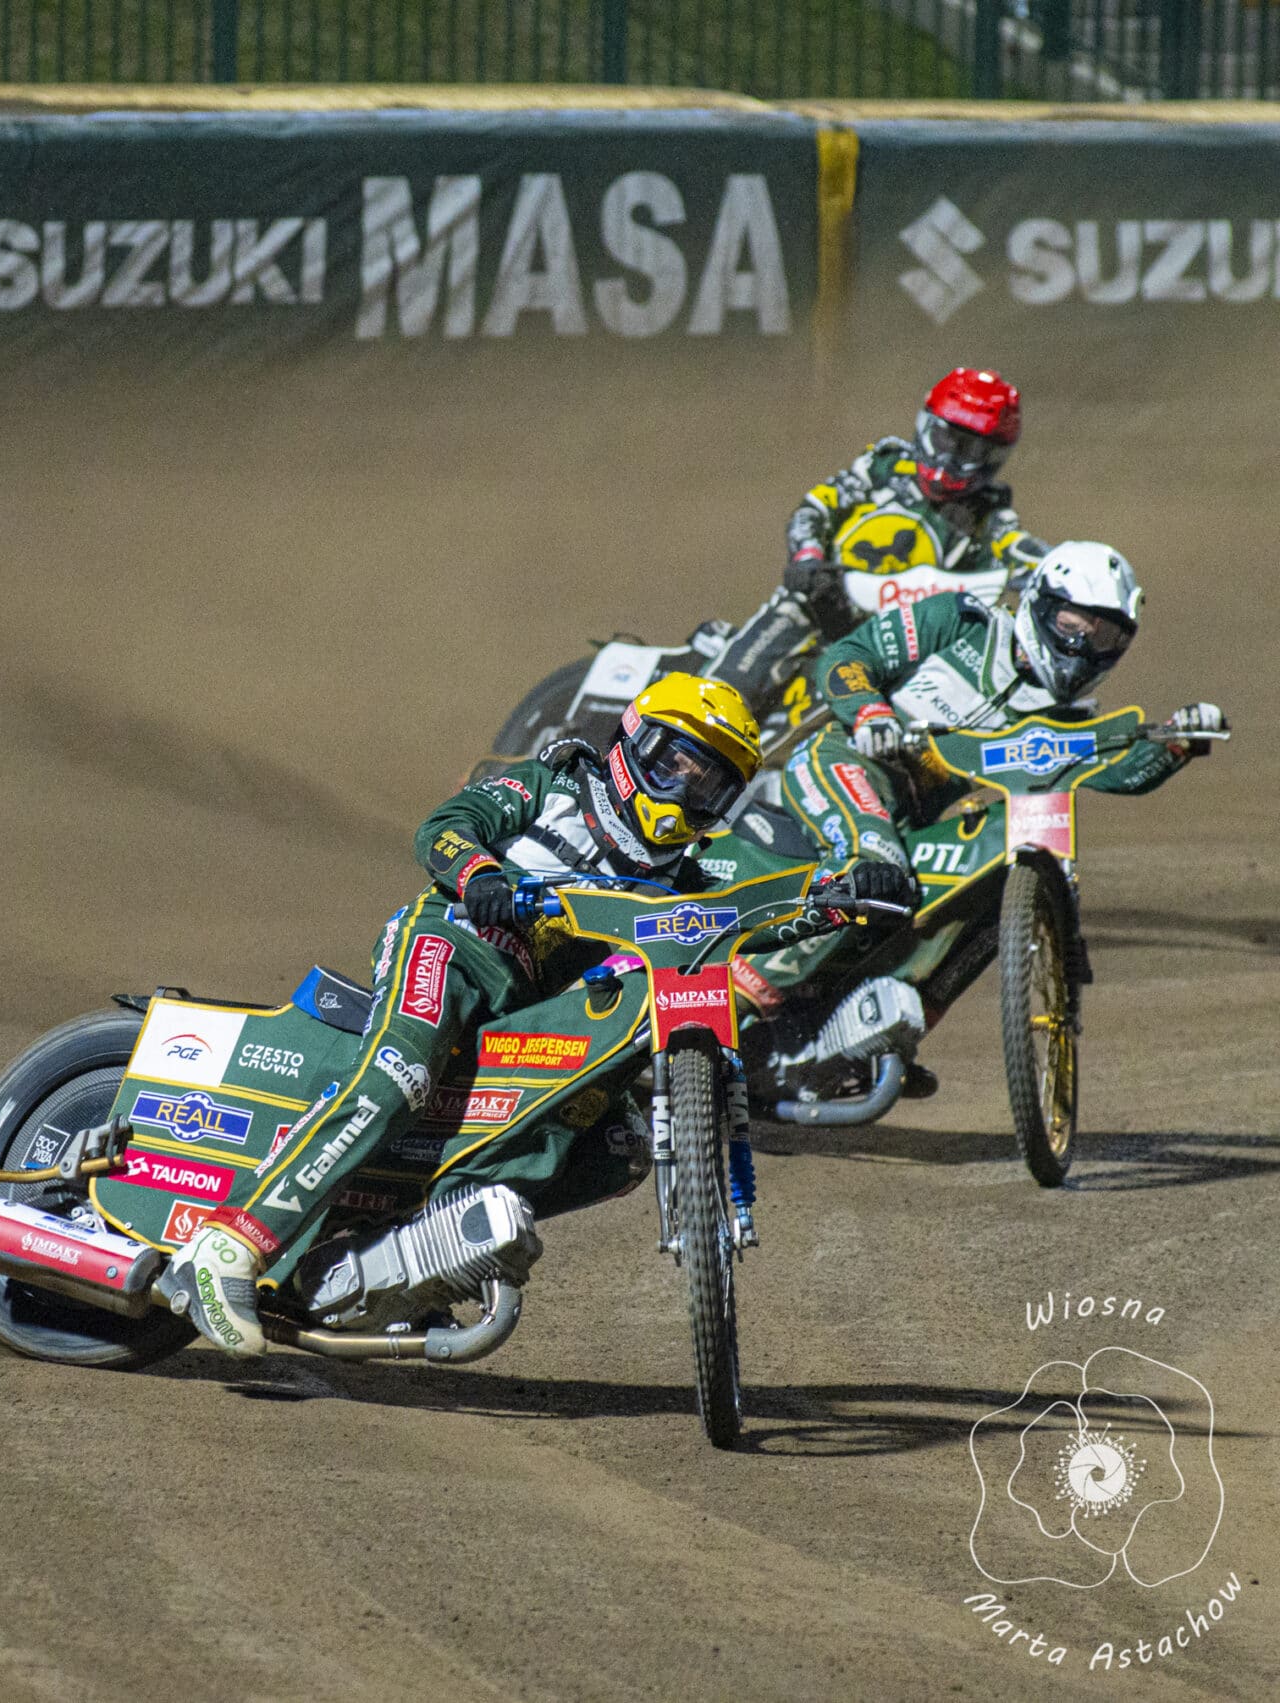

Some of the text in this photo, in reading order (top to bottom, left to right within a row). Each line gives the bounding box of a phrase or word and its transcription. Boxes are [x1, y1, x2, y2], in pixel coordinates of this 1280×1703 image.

[355, 171, 792, 339] MASA
[1007, 217, 1280, 306] SUZU
[656, 914, 722, 934] REALL
[418, 937, 439, 1000] IMPAKT
[669, 989, 728, 1002] IMPAKT
[167, 1044, 204, 1061] PGE
[484, 1036, 589, 1057] VIGGO JESPERSEN
[377, 1046, 426, 1104] Center
[156, 1102, 225, 1132] REALL
[295, 1094, 382, 1191] Galmet
[151, 1162, 222, 1193] TAURON
[32, 1236, 83, 1260] IMPAKT
[197, 1267, 245, 1346] daytona
